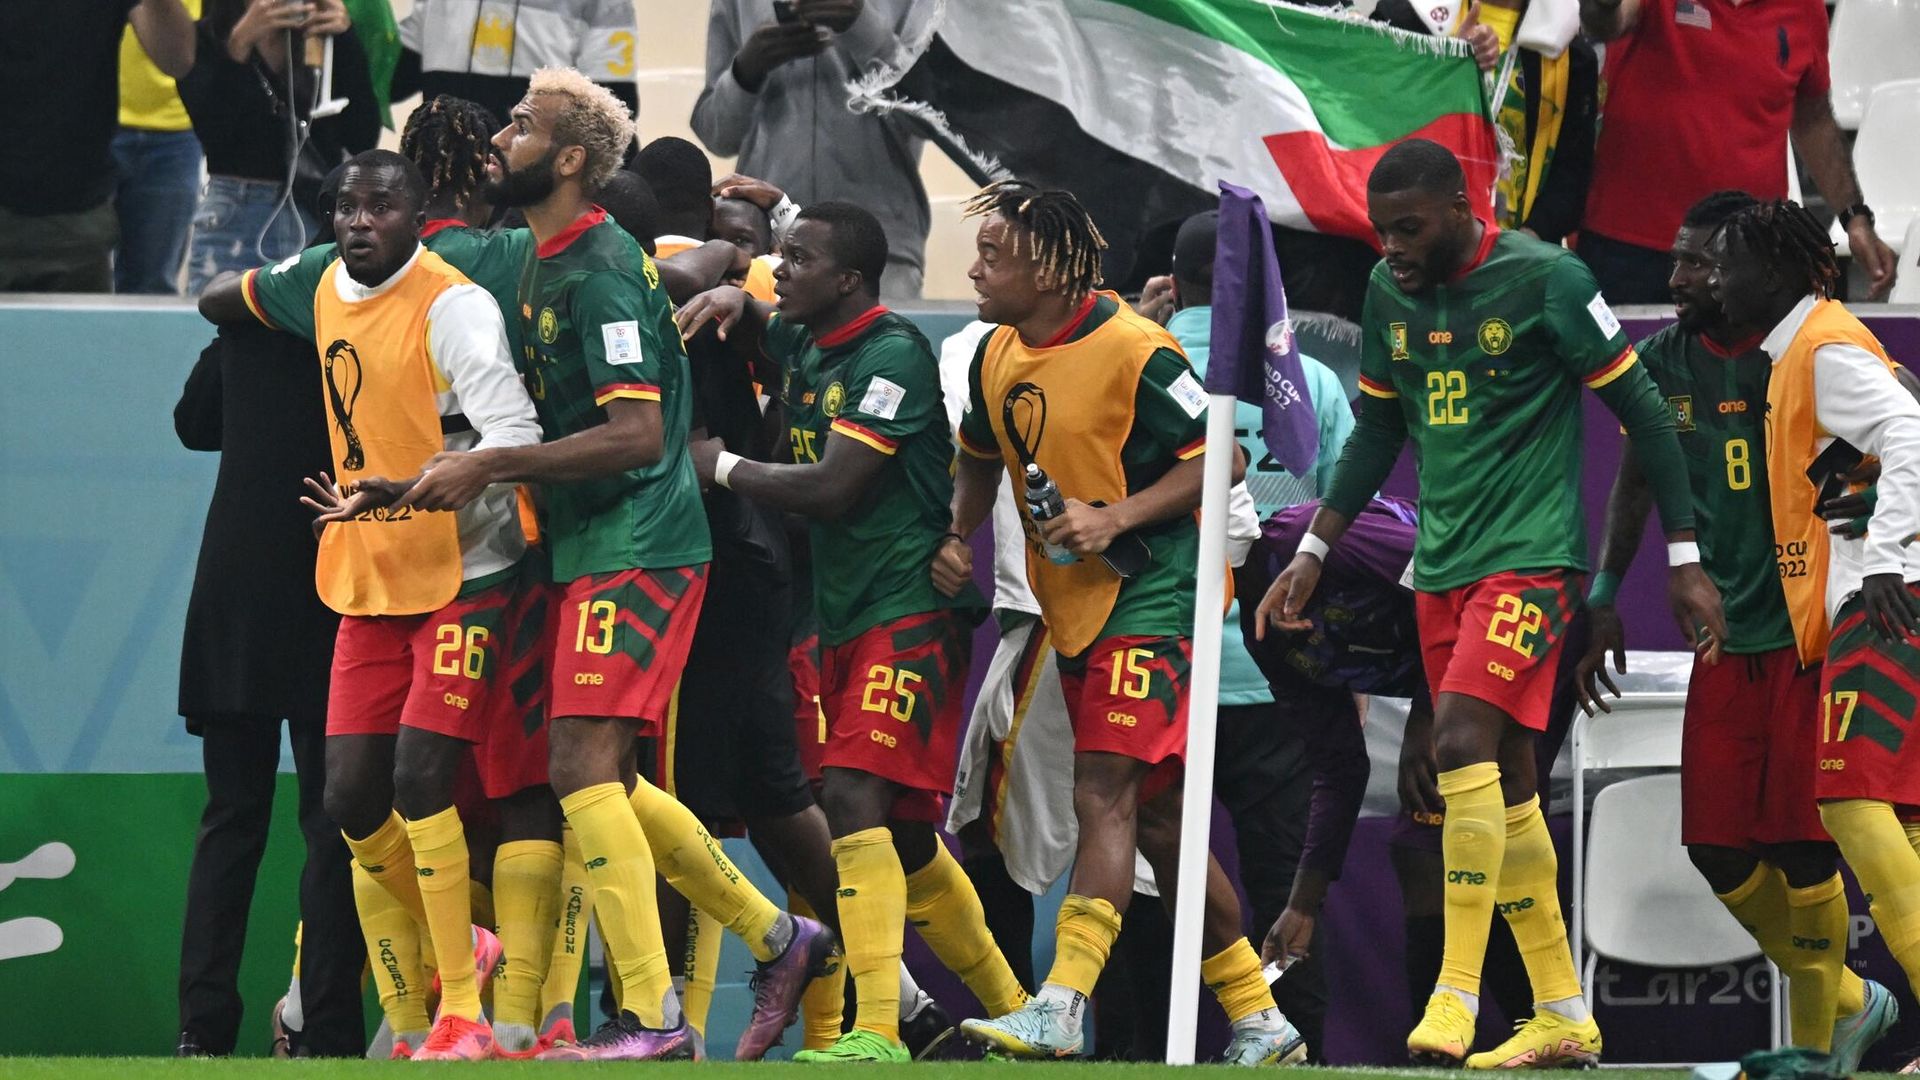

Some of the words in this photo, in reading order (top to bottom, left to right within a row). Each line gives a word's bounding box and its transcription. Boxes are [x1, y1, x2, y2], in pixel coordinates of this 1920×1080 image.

[607, 31, 635, 77] 3
[1428, 331, 1453, 344] one
[1427, 370, 1469, 425] 22
[1718, 400, 1747, 413] one
[1725, 438, 1751, 490] 8
[575, 599, 617, 654] 13
[1485, 593, 1543, 659] 22
[433, 623, 489, 680] 26
[574, 672, 604, 685] one
[1109, 648, 1154, 699] 15
[1487, 661, 1515, 681] one
[443, 692, 470, 710] one
[861, 664, 922, 723] 25
[1107, 711, 1137, 727] one
[1823, 690, 1858, 743] 17
[870, 729, 897, 748] one
[1820, 759, 1845, 770] one
[1447, 870, 1486, 885] one
[565, 886, 584, 954] CAMEROUN
[1793, 936, 1831, 950] one
